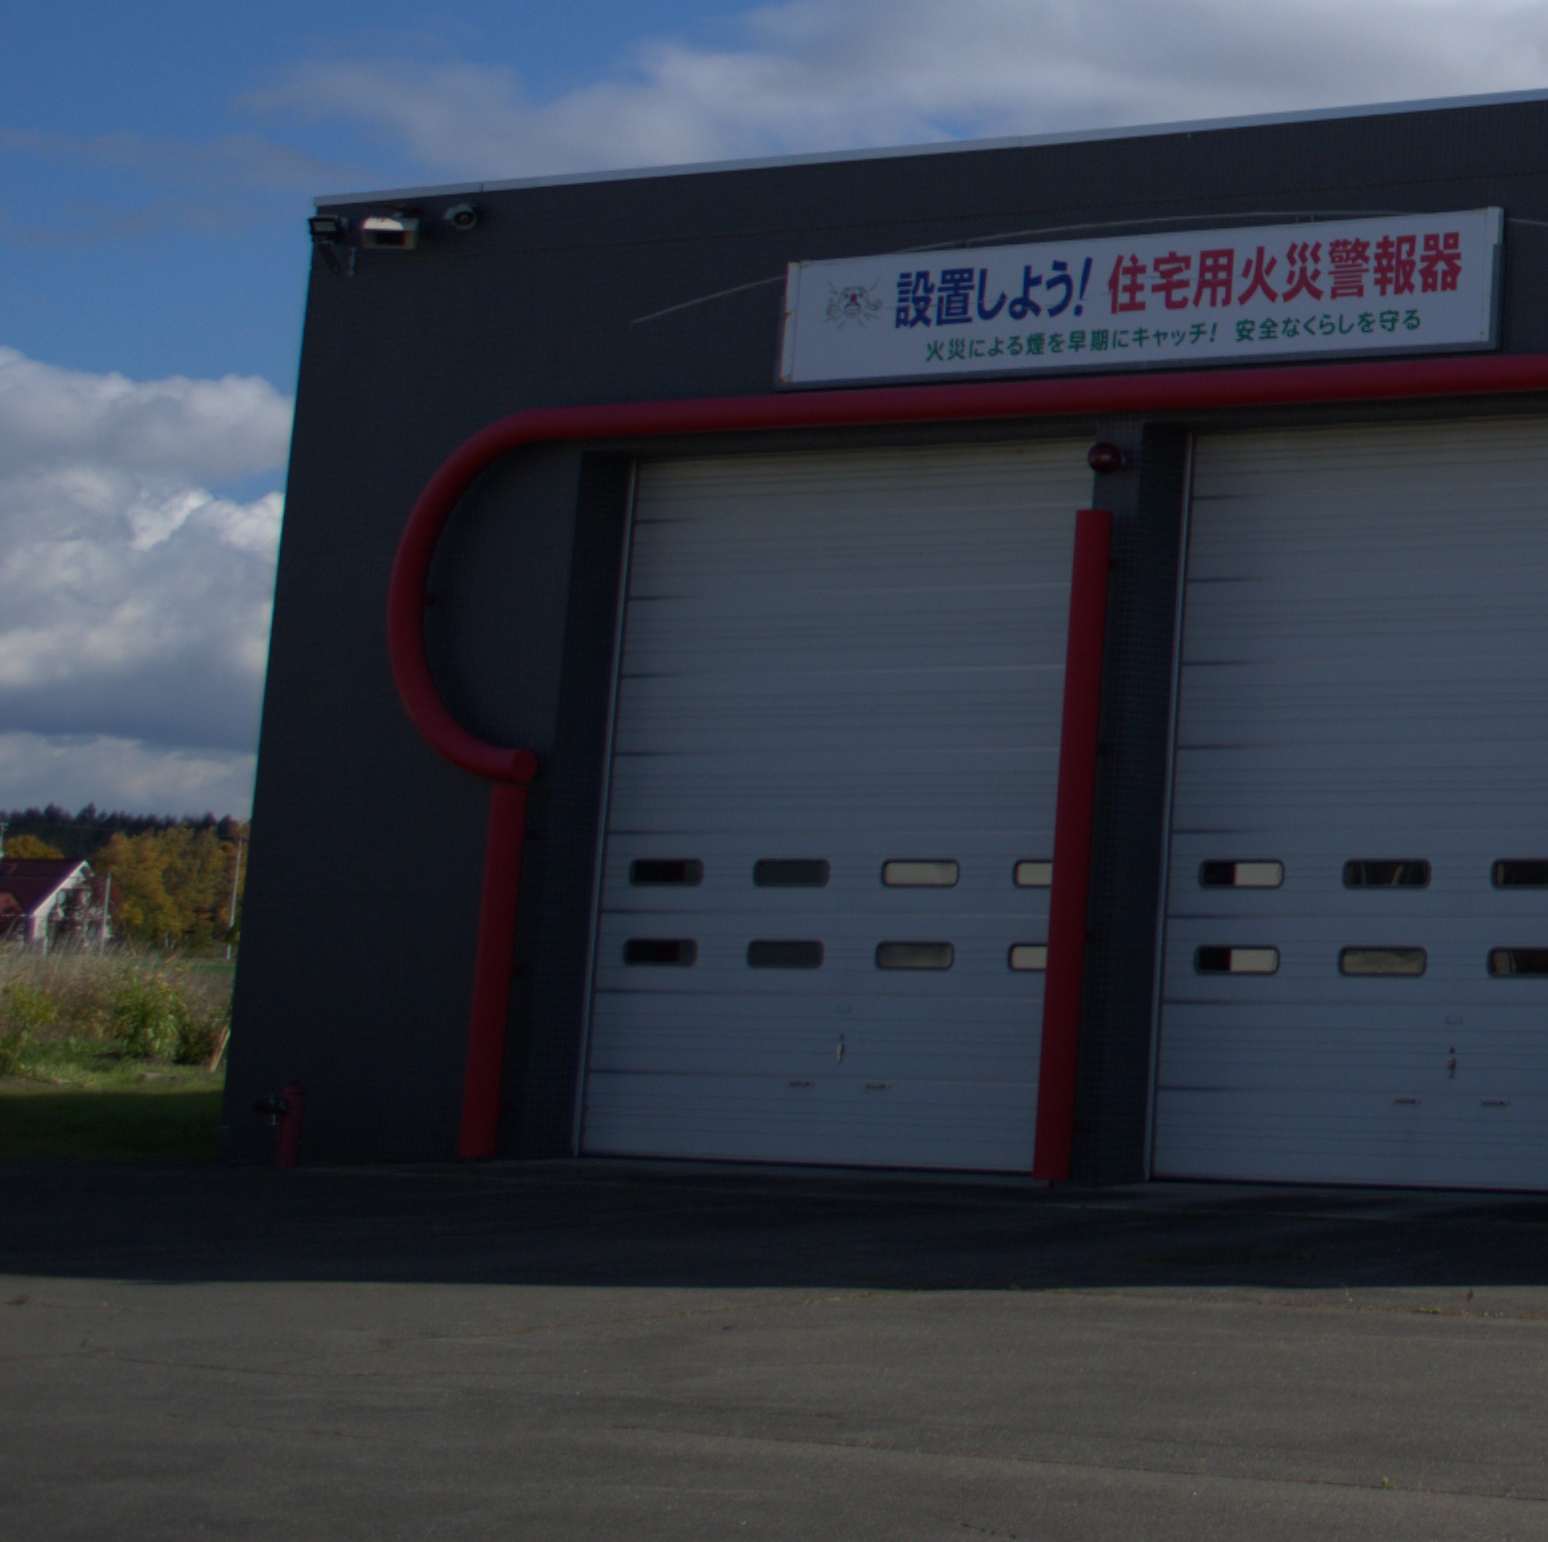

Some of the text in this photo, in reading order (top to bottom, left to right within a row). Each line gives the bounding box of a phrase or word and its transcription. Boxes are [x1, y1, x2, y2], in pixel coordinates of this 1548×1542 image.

[895, 231, 1463, 329] 設置しよう！ 住宅用火災警報器
[925, 309, 1421, 362] 火災による煙を早期にキャッチ！ 安全なくらしを守る
